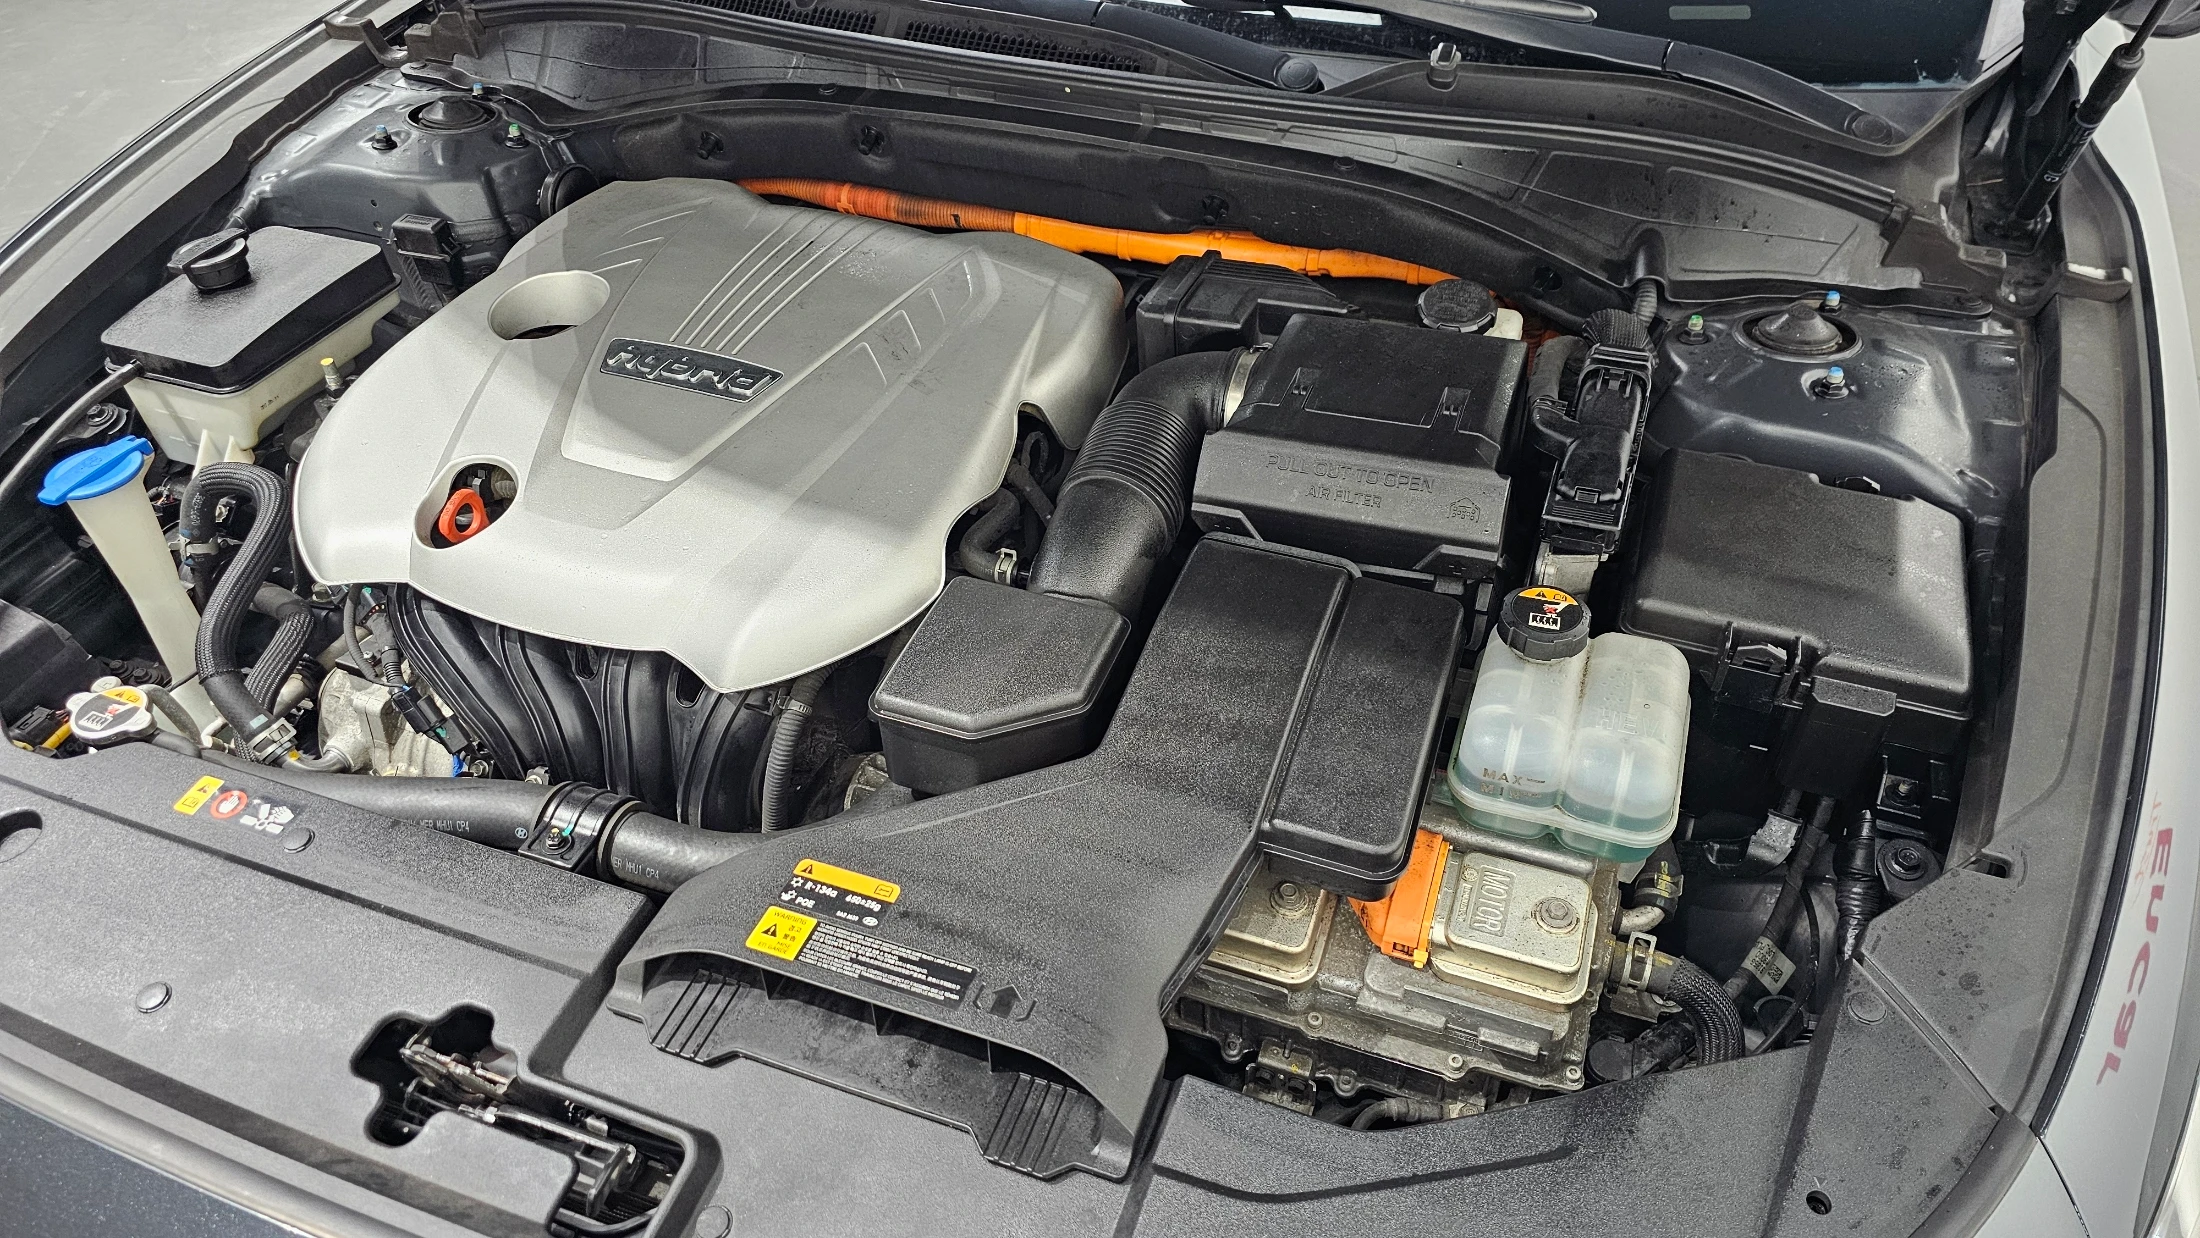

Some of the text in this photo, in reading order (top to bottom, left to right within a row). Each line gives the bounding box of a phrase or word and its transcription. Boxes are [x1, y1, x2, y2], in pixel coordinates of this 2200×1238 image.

[1265, 454, 1436, 494] PULL OUT TO OPEN
[1305, 484, 1383, 509] AIR FILTER
[1482, 767, 1523, 787] MAX
[804, 881, 839, 898] R-134a
[795, 896, 816, 909] POE
[1472, 870, 1512, 932] MOTOR
